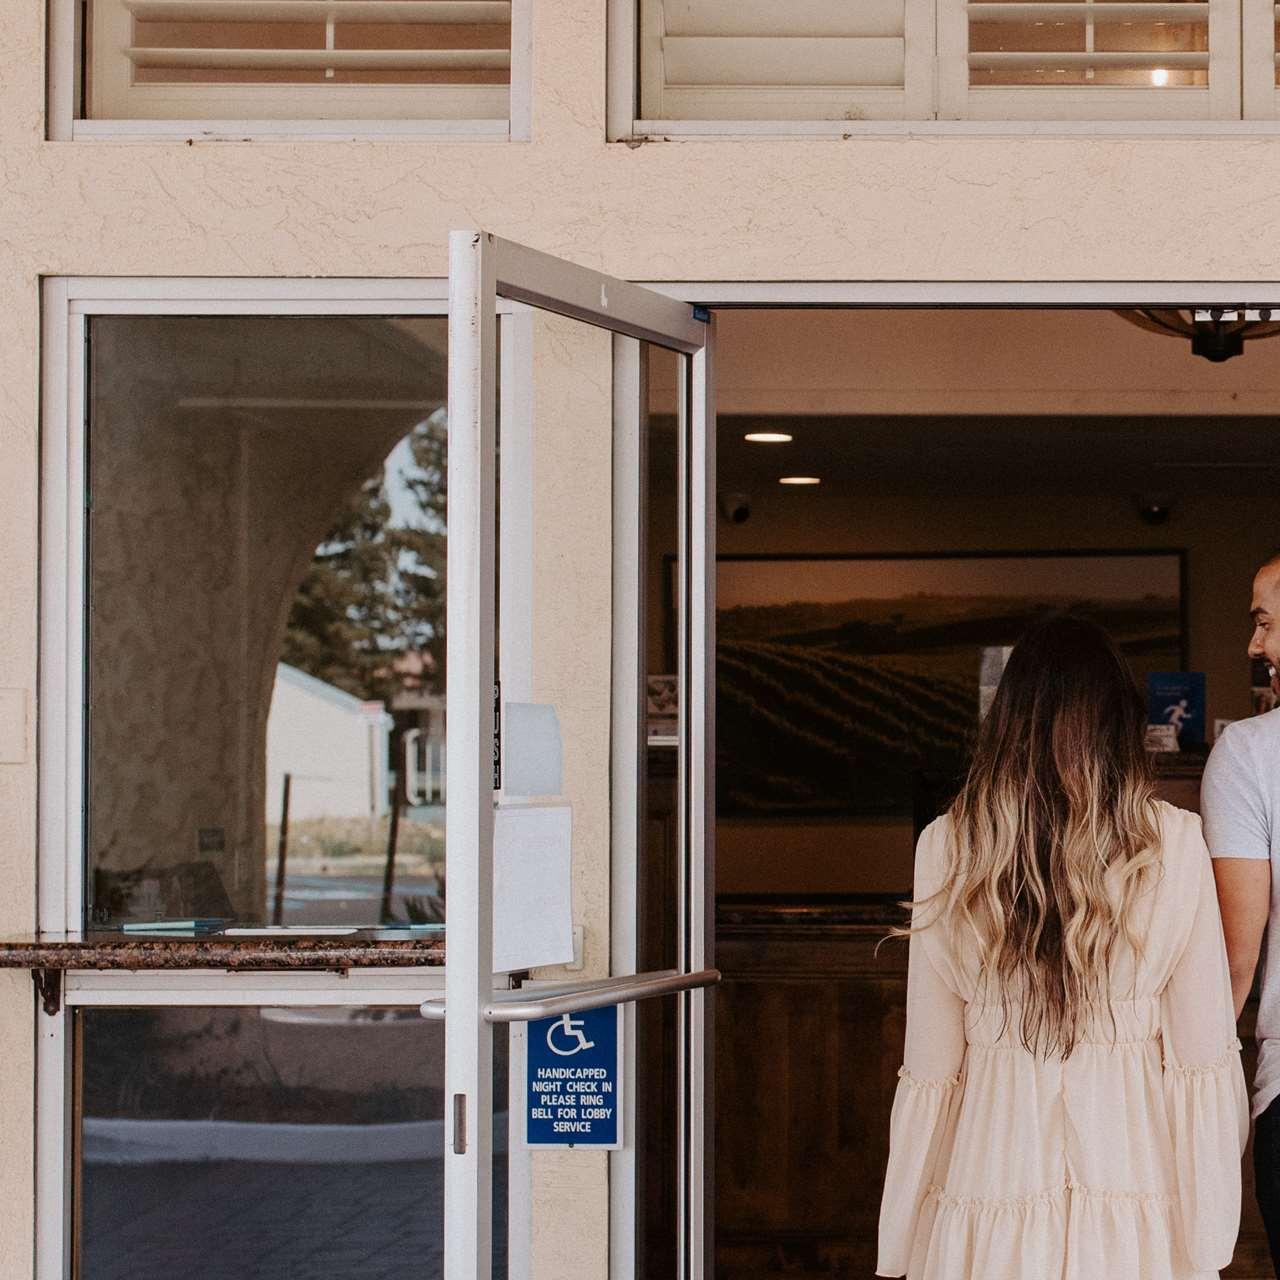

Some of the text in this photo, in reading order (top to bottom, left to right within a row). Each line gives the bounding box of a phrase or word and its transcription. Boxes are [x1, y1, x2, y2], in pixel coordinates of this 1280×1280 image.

[537, 1068, 607, 1079] HANDICAPPED
[532, 1081, 612, 1093] NIGHT CHECK IN
[541, 1094, 603, 1106] PLEASE RING
[531, 1108, 612, 1119] BELL FOR LOBBY
[553, 1121, 592, 1133] SERVICE
